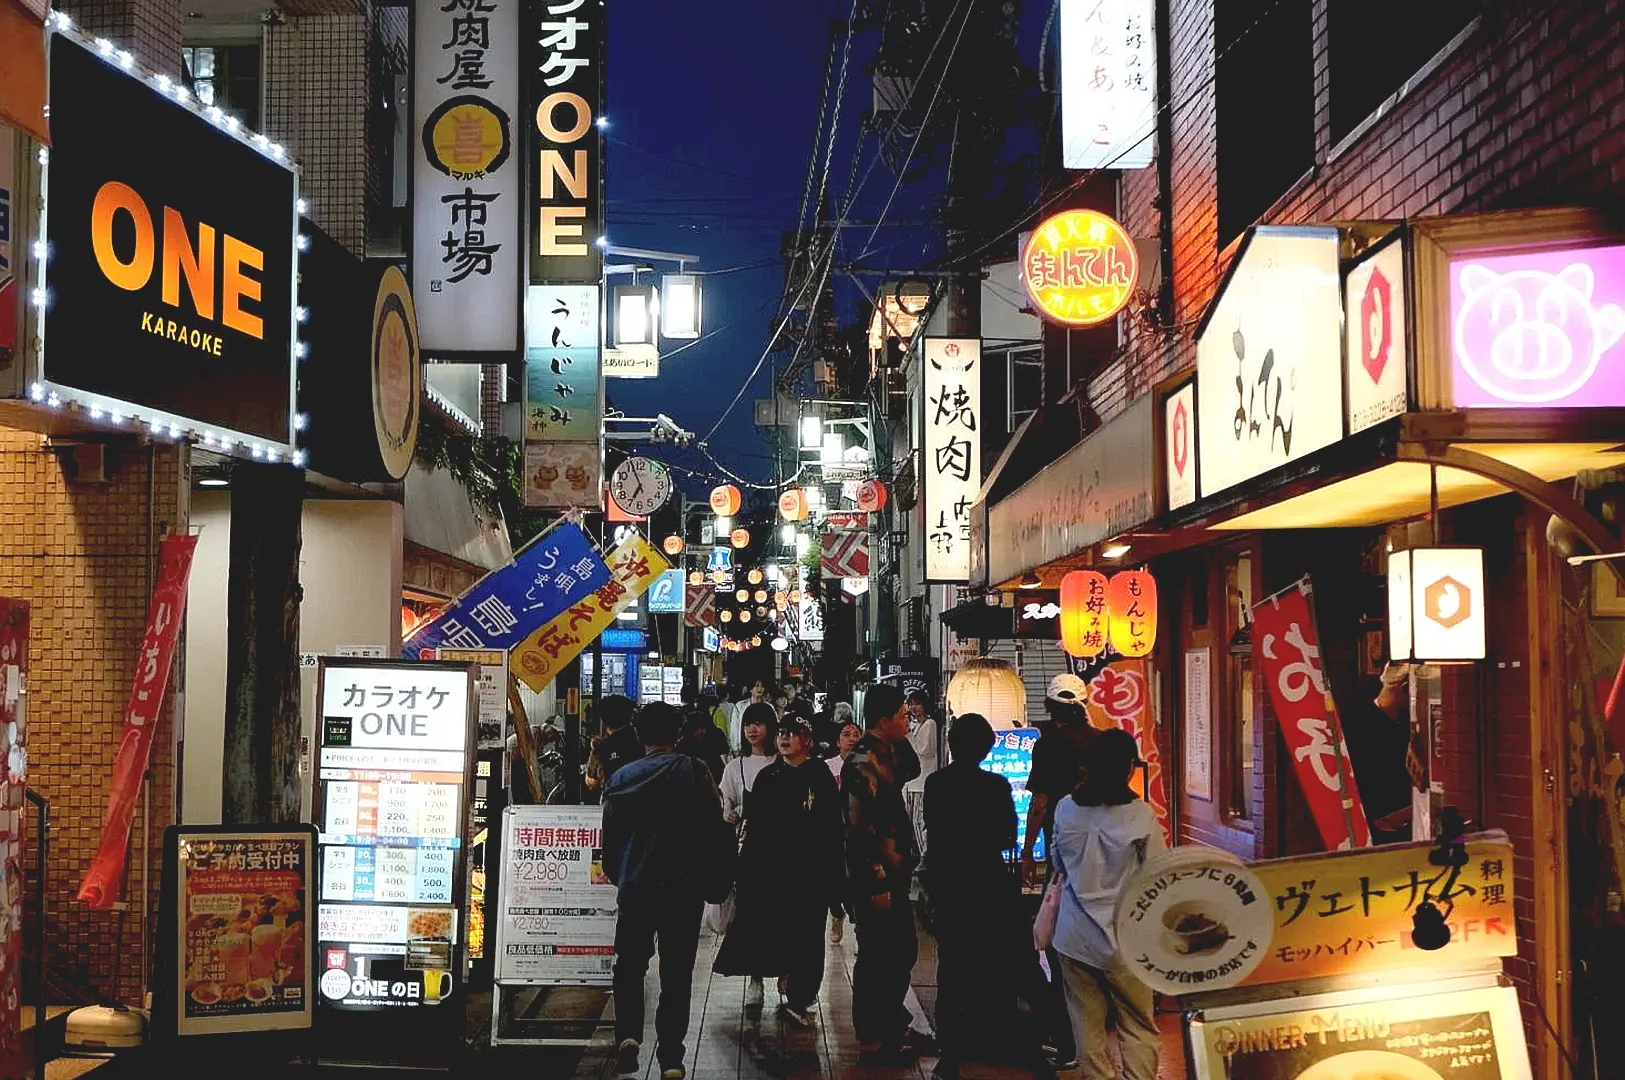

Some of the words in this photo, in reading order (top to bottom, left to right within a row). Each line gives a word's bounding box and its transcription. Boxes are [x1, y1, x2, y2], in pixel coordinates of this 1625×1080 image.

[437, 0, 497, 90] 肉屋
[451, 170, 487, 180] マルキ
[536, 91, 592, 256] ONE
[441, 187, 502, 284] 市場
[91, 180, 264, 340] ONE
[1031, 246, 1131, 290] まんてん
[141, 311, 224, 356] KARAOKE
[550, 297, 575, 427] うんじゃみ
[930, 384, 977, 482] 焼肉
[618, 472, 628, 481] 10
[636, 462, 646, 471] 12
[619, 491, 627, 500] 8
[654, 491, 661, 500] 4
[657, 481, 664, 490] 3
[636, 501, 643, 510] 6
[646, 498, 653, 508] 5
[537, 549, 651, 660] 沖縄そば
[1083, 578, 1105, 648] お好み焼
[1126, 578, 1146, 652] もんじゃ
[343, 683, 450, 710] カラオケ
[360, 713, 428, 736] ONE
[513, 828, 603, 848] 時間無制
[193, 852, 300, 871] ご予約受付中
[512, 849, 581, 861] 焼肉食べ放題
[513, 862, 568, 881] ¥2,980
[1480, 858, 1508, 907] 料理
[1276, 865, 1476, 928] ヴェトナム
[512, 916, 550, 931] ¥2,780
[1276, 936, 1396, 964] モッハイバー
[352, 981, 389, 997] ONE
[391, 982, 420, 998] の日
[1215, 1023, 1306, 1057] DINNER
[1310, 1011, 1391, 1047] MENU
